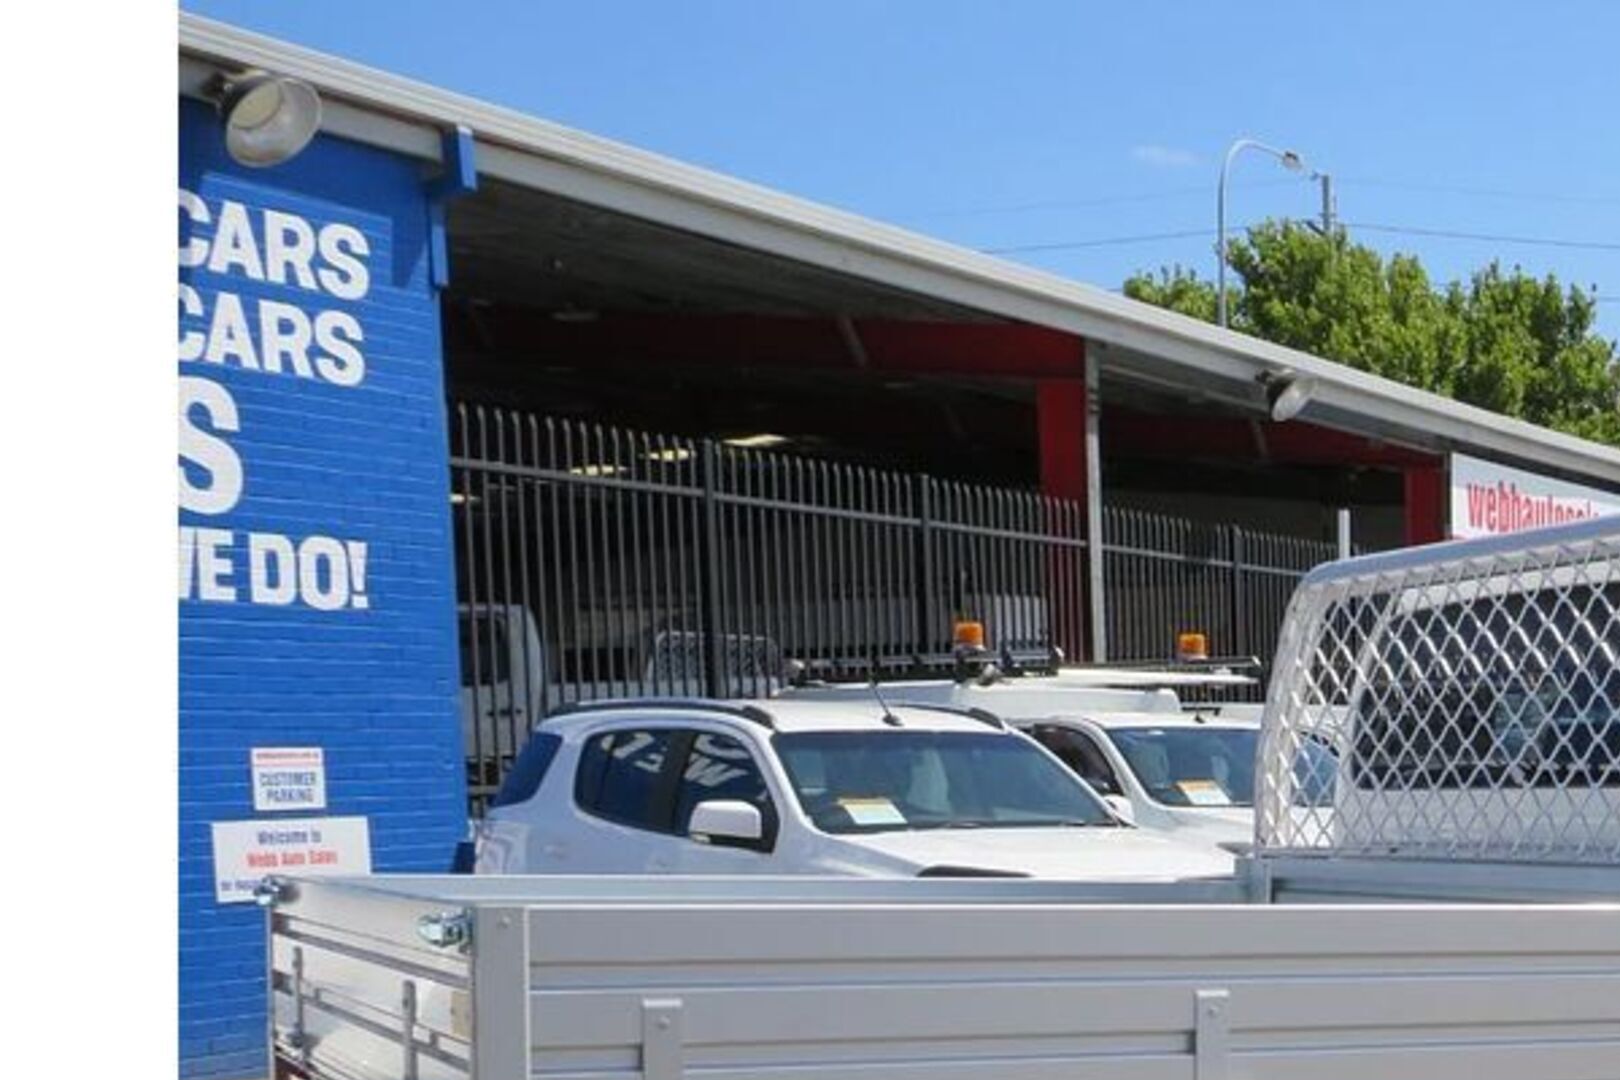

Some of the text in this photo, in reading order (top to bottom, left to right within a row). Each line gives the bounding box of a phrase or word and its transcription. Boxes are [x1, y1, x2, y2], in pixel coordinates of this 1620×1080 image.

[249, 532, 369, 611] DO!
[259, 772, 316, 787] CUSTOMER
[266, 788, 314, 803] PARKING
[258, 830, 322, 845] Welcome to
